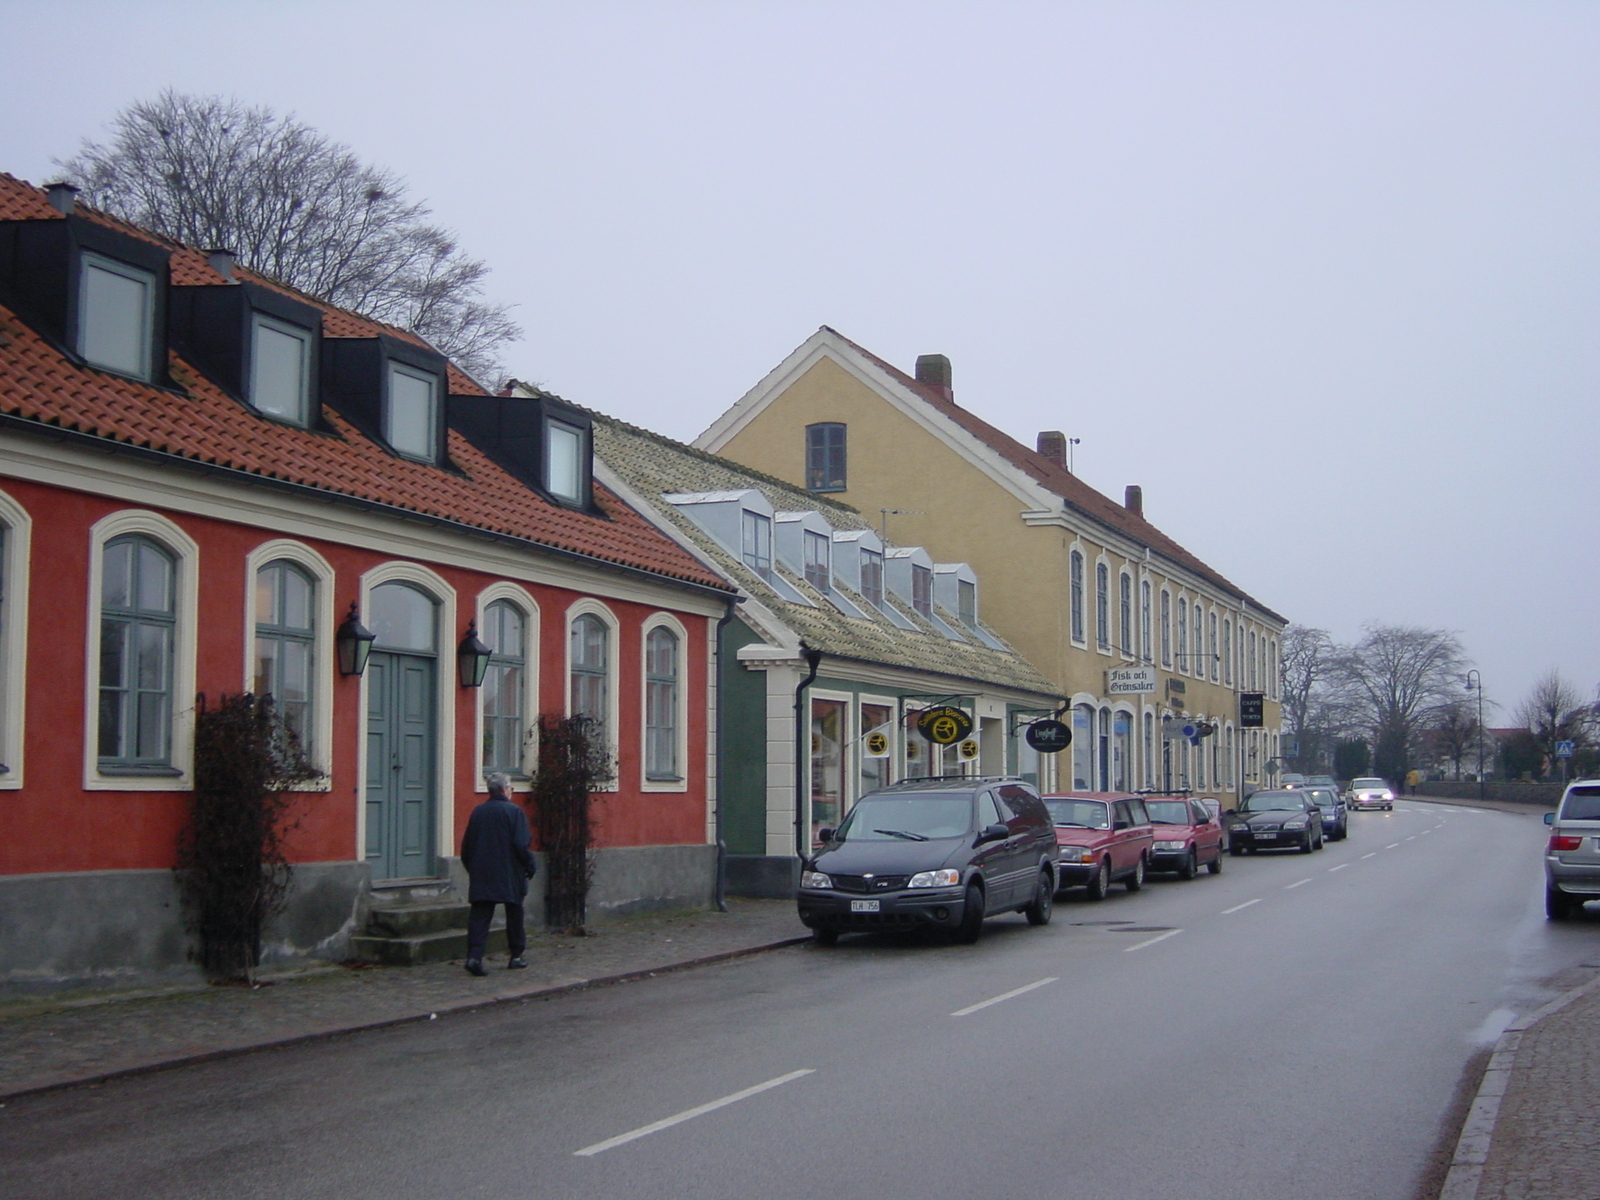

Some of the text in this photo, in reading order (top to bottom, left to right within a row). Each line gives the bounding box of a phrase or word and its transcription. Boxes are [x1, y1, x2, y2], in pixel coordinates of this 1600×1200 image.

[1111, 671, 1147, 681] Fisk och
[1110, 682, 1153, 692] Grönsaker
